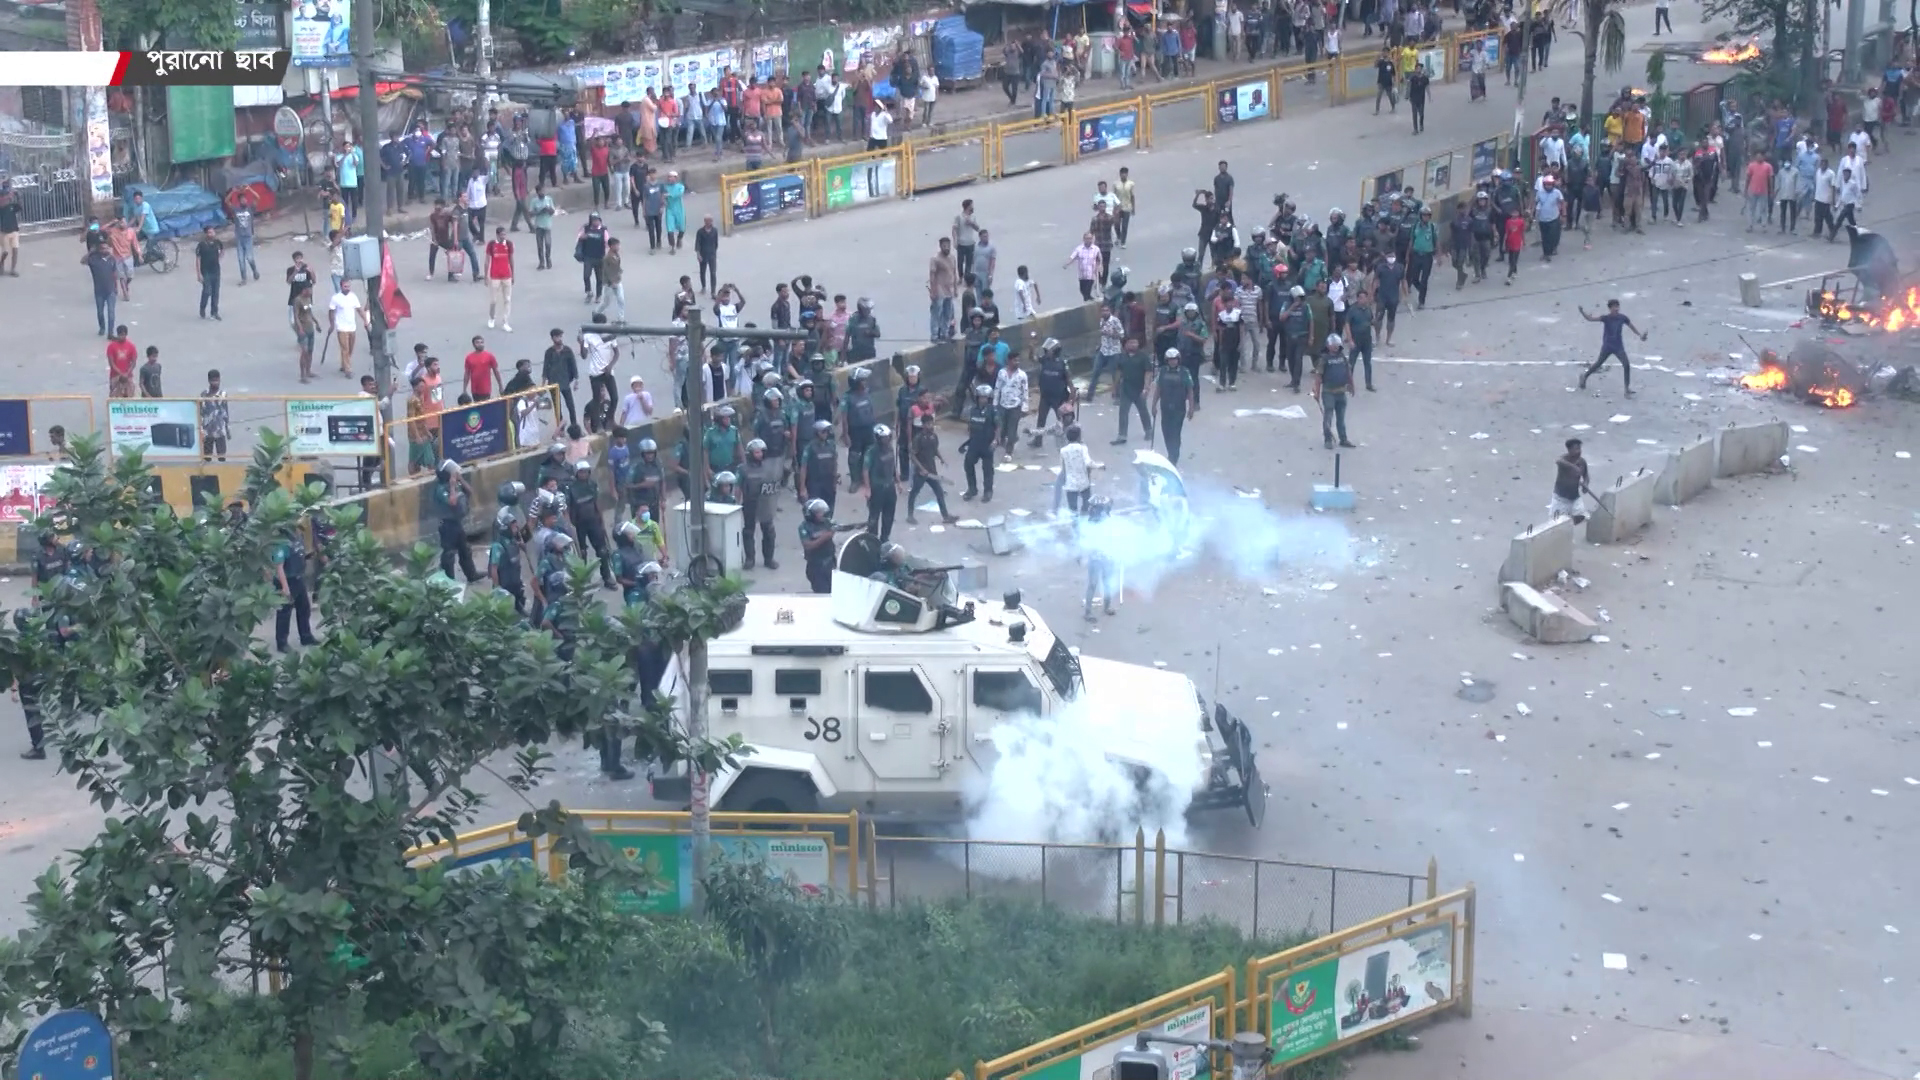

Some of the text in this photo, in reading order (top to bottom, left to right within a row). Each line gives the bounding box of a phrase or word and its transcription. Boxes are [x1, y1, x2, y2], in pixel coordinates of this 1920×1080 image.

[111, 404, 159, 414] minister
[290, 402, 334, 412] minister
[803, 715, 842, 743] ১৪
[770, 842, 824, 852] minister
[1167, 1010, 1206, 1031] minister
